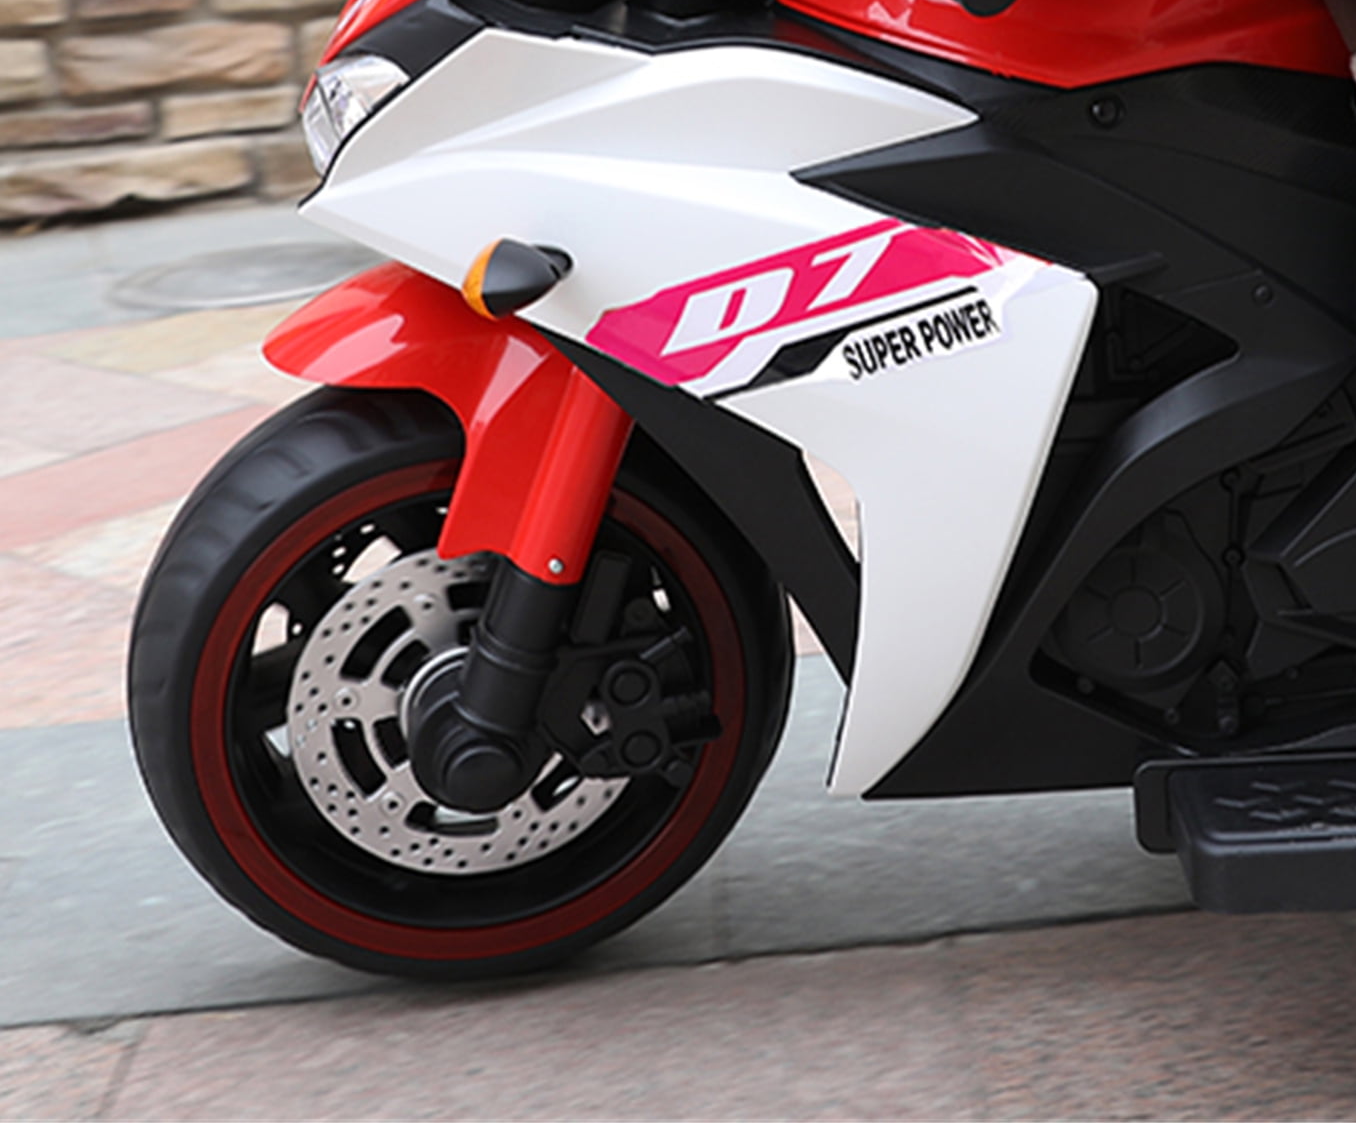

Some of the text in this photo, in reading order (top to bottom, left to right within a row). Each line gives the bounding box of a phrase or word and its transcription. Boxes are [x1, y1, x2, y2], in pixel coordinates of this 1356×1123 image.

[660, 229, 896, 357] D7
[842, 298, 1001, 380] SUPER POWER
